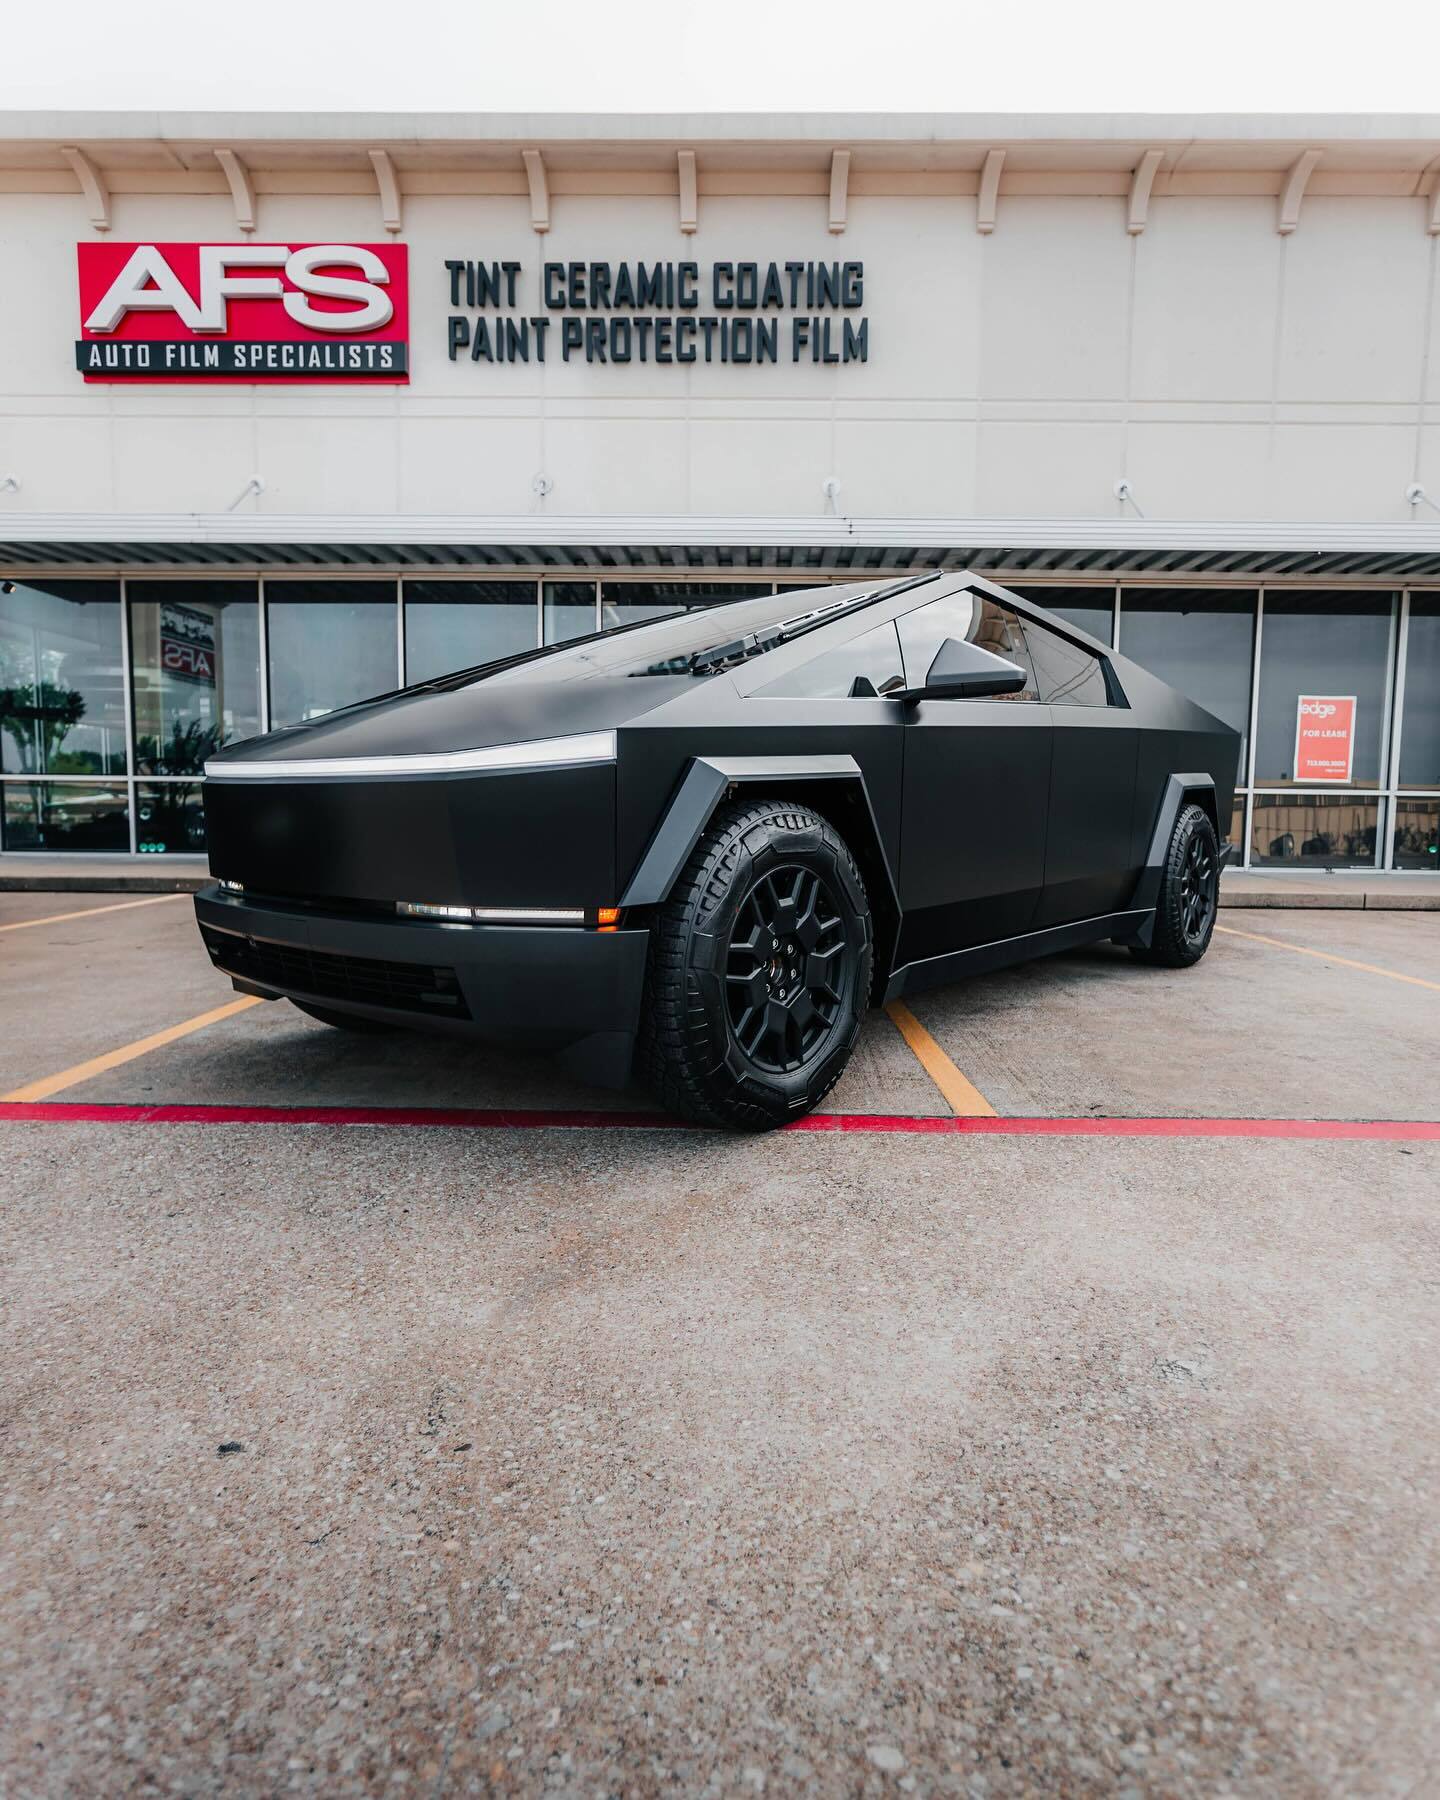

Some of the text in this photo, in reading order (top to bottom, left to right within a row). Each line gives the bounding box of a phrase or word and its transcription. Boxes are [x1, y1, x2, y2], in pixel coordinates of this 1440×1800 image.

[84, 245, 394, 333] AFS
[444, 260, 863, 309] TINT CERAMIC COATING
[89, 345, 393, 367] AUTO FILM SPECIALISTS
[448, 316, 869, 363] PAINT PROTECTION FILM
[1301, 701, 1336, 718] edge
[1322, 730, 1347, 738] LEASE
